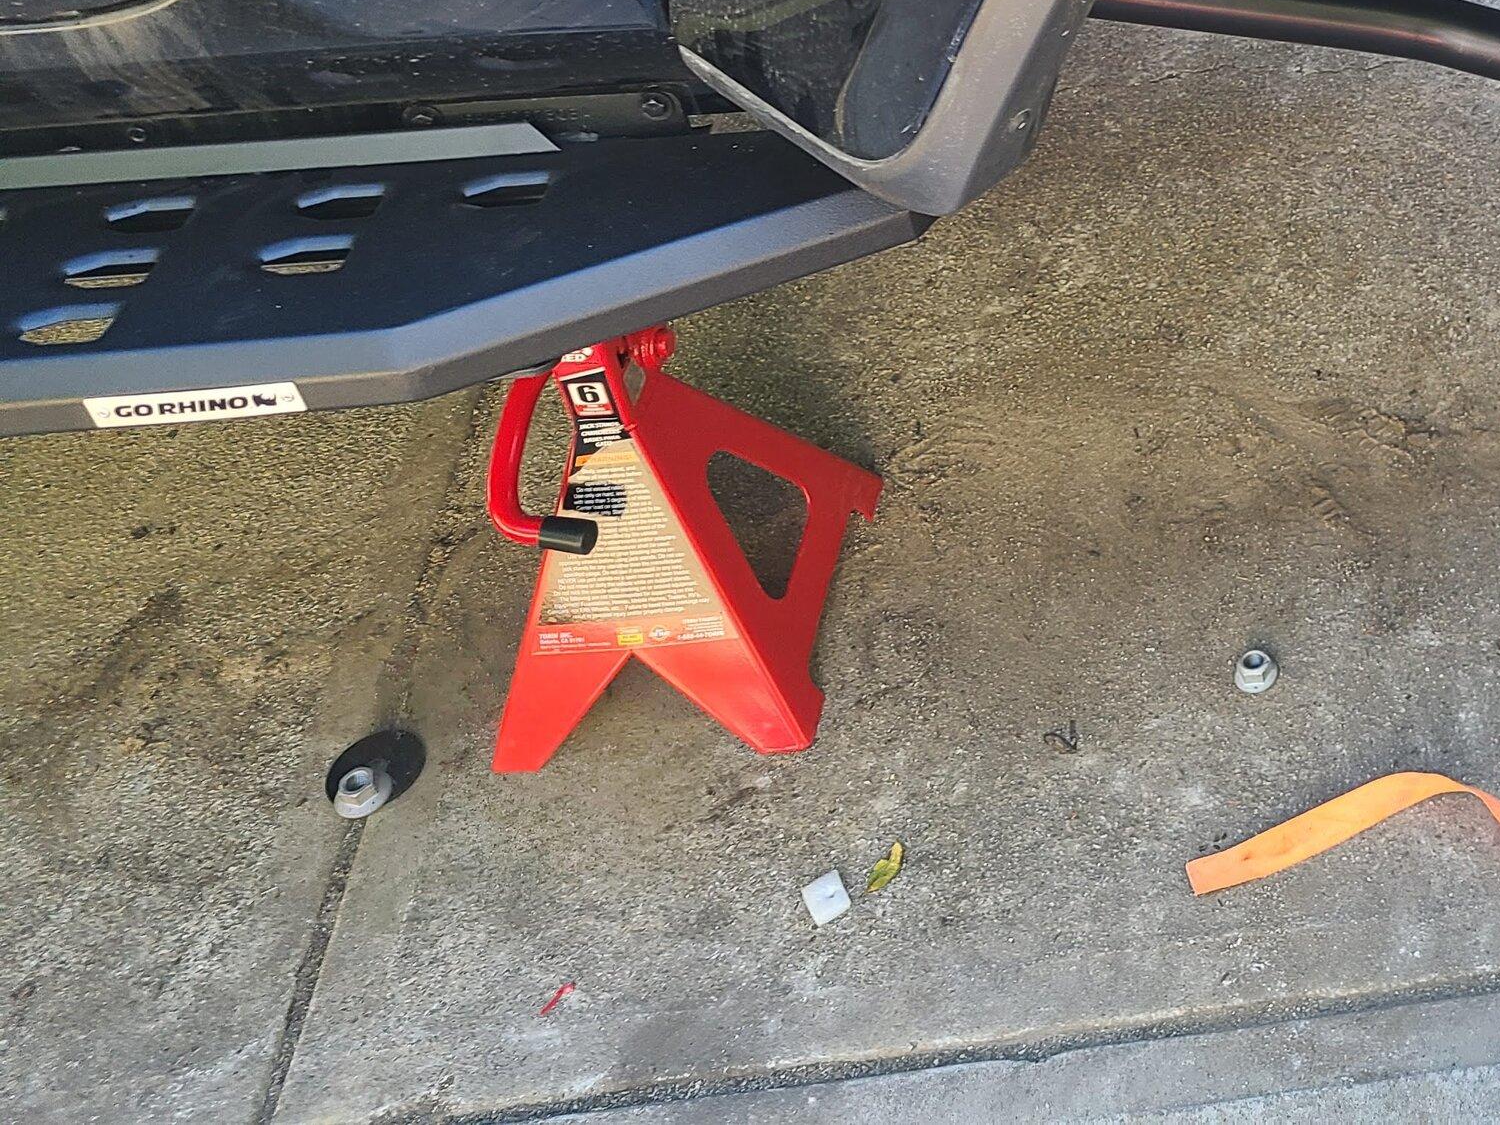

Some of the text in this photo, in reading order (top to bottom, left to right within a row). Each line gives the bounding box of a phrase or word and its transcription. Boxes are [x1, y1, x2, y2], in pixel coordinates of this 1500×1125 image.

[576, 385, 600, 403] 6
[114, 396, 249, 418] GO RHINO
